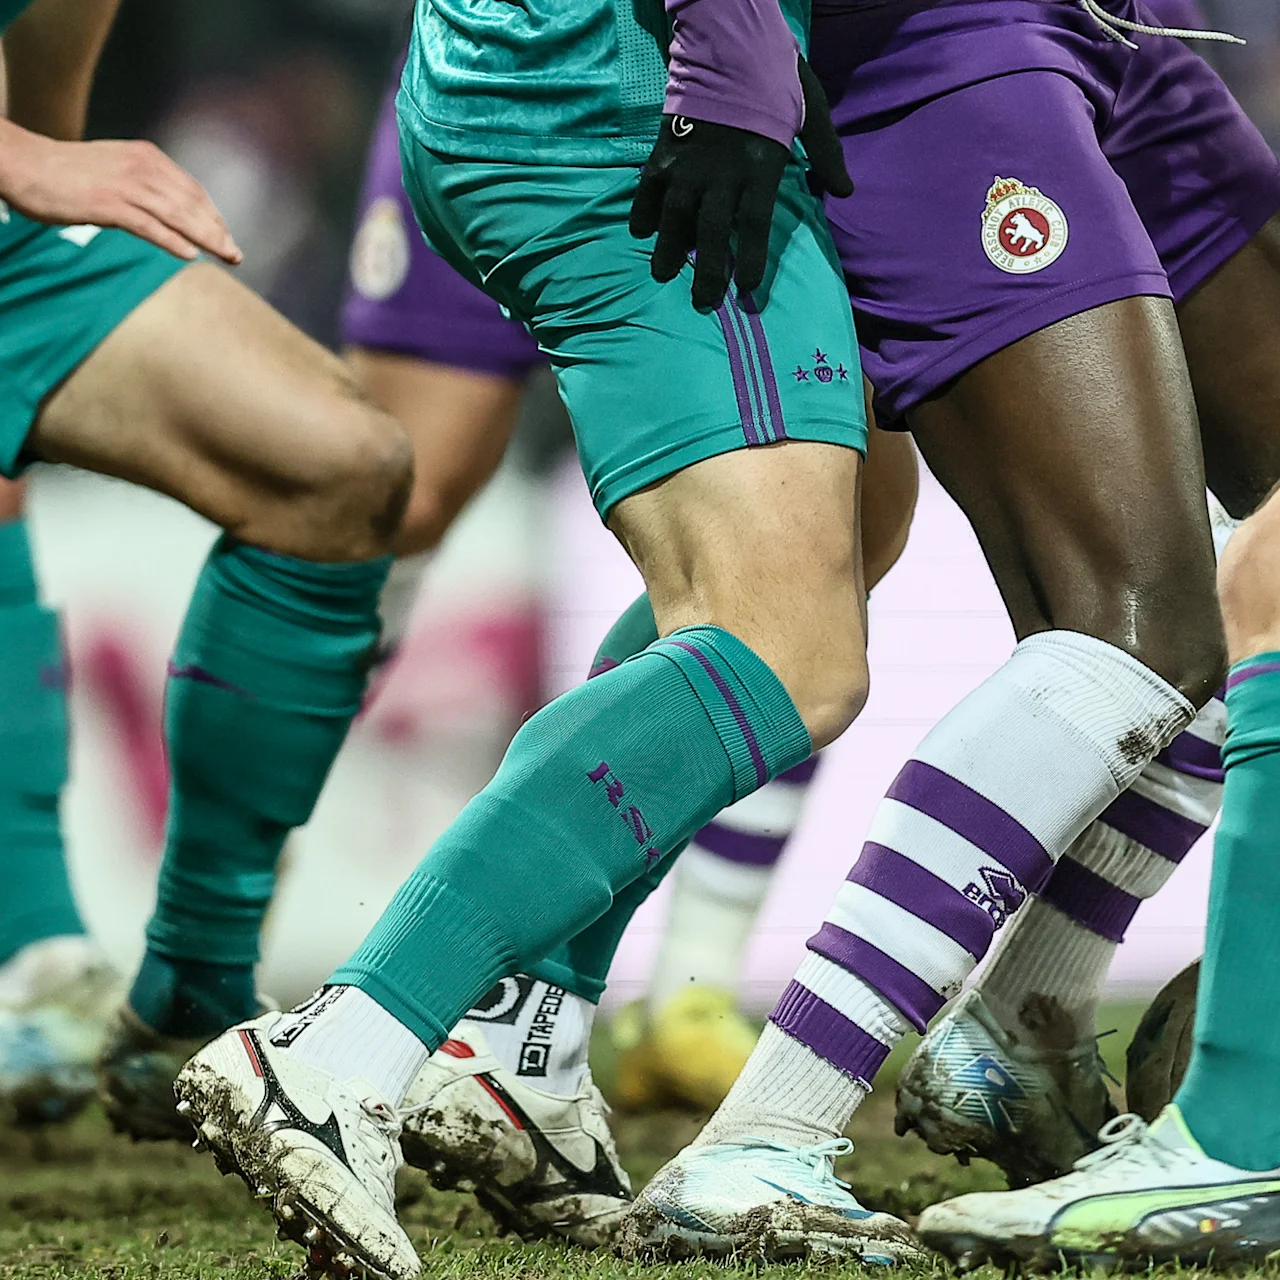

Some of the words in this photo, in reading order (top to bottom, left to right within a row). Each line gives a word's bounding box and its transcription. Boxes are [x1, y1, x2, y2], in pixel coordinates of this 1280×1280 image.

[986, 208, 1015, 268] BEERSCHOT
[1008, 196, 1053, 216] ATLETIC
[1049, 220, 1063, 248] CLUB
